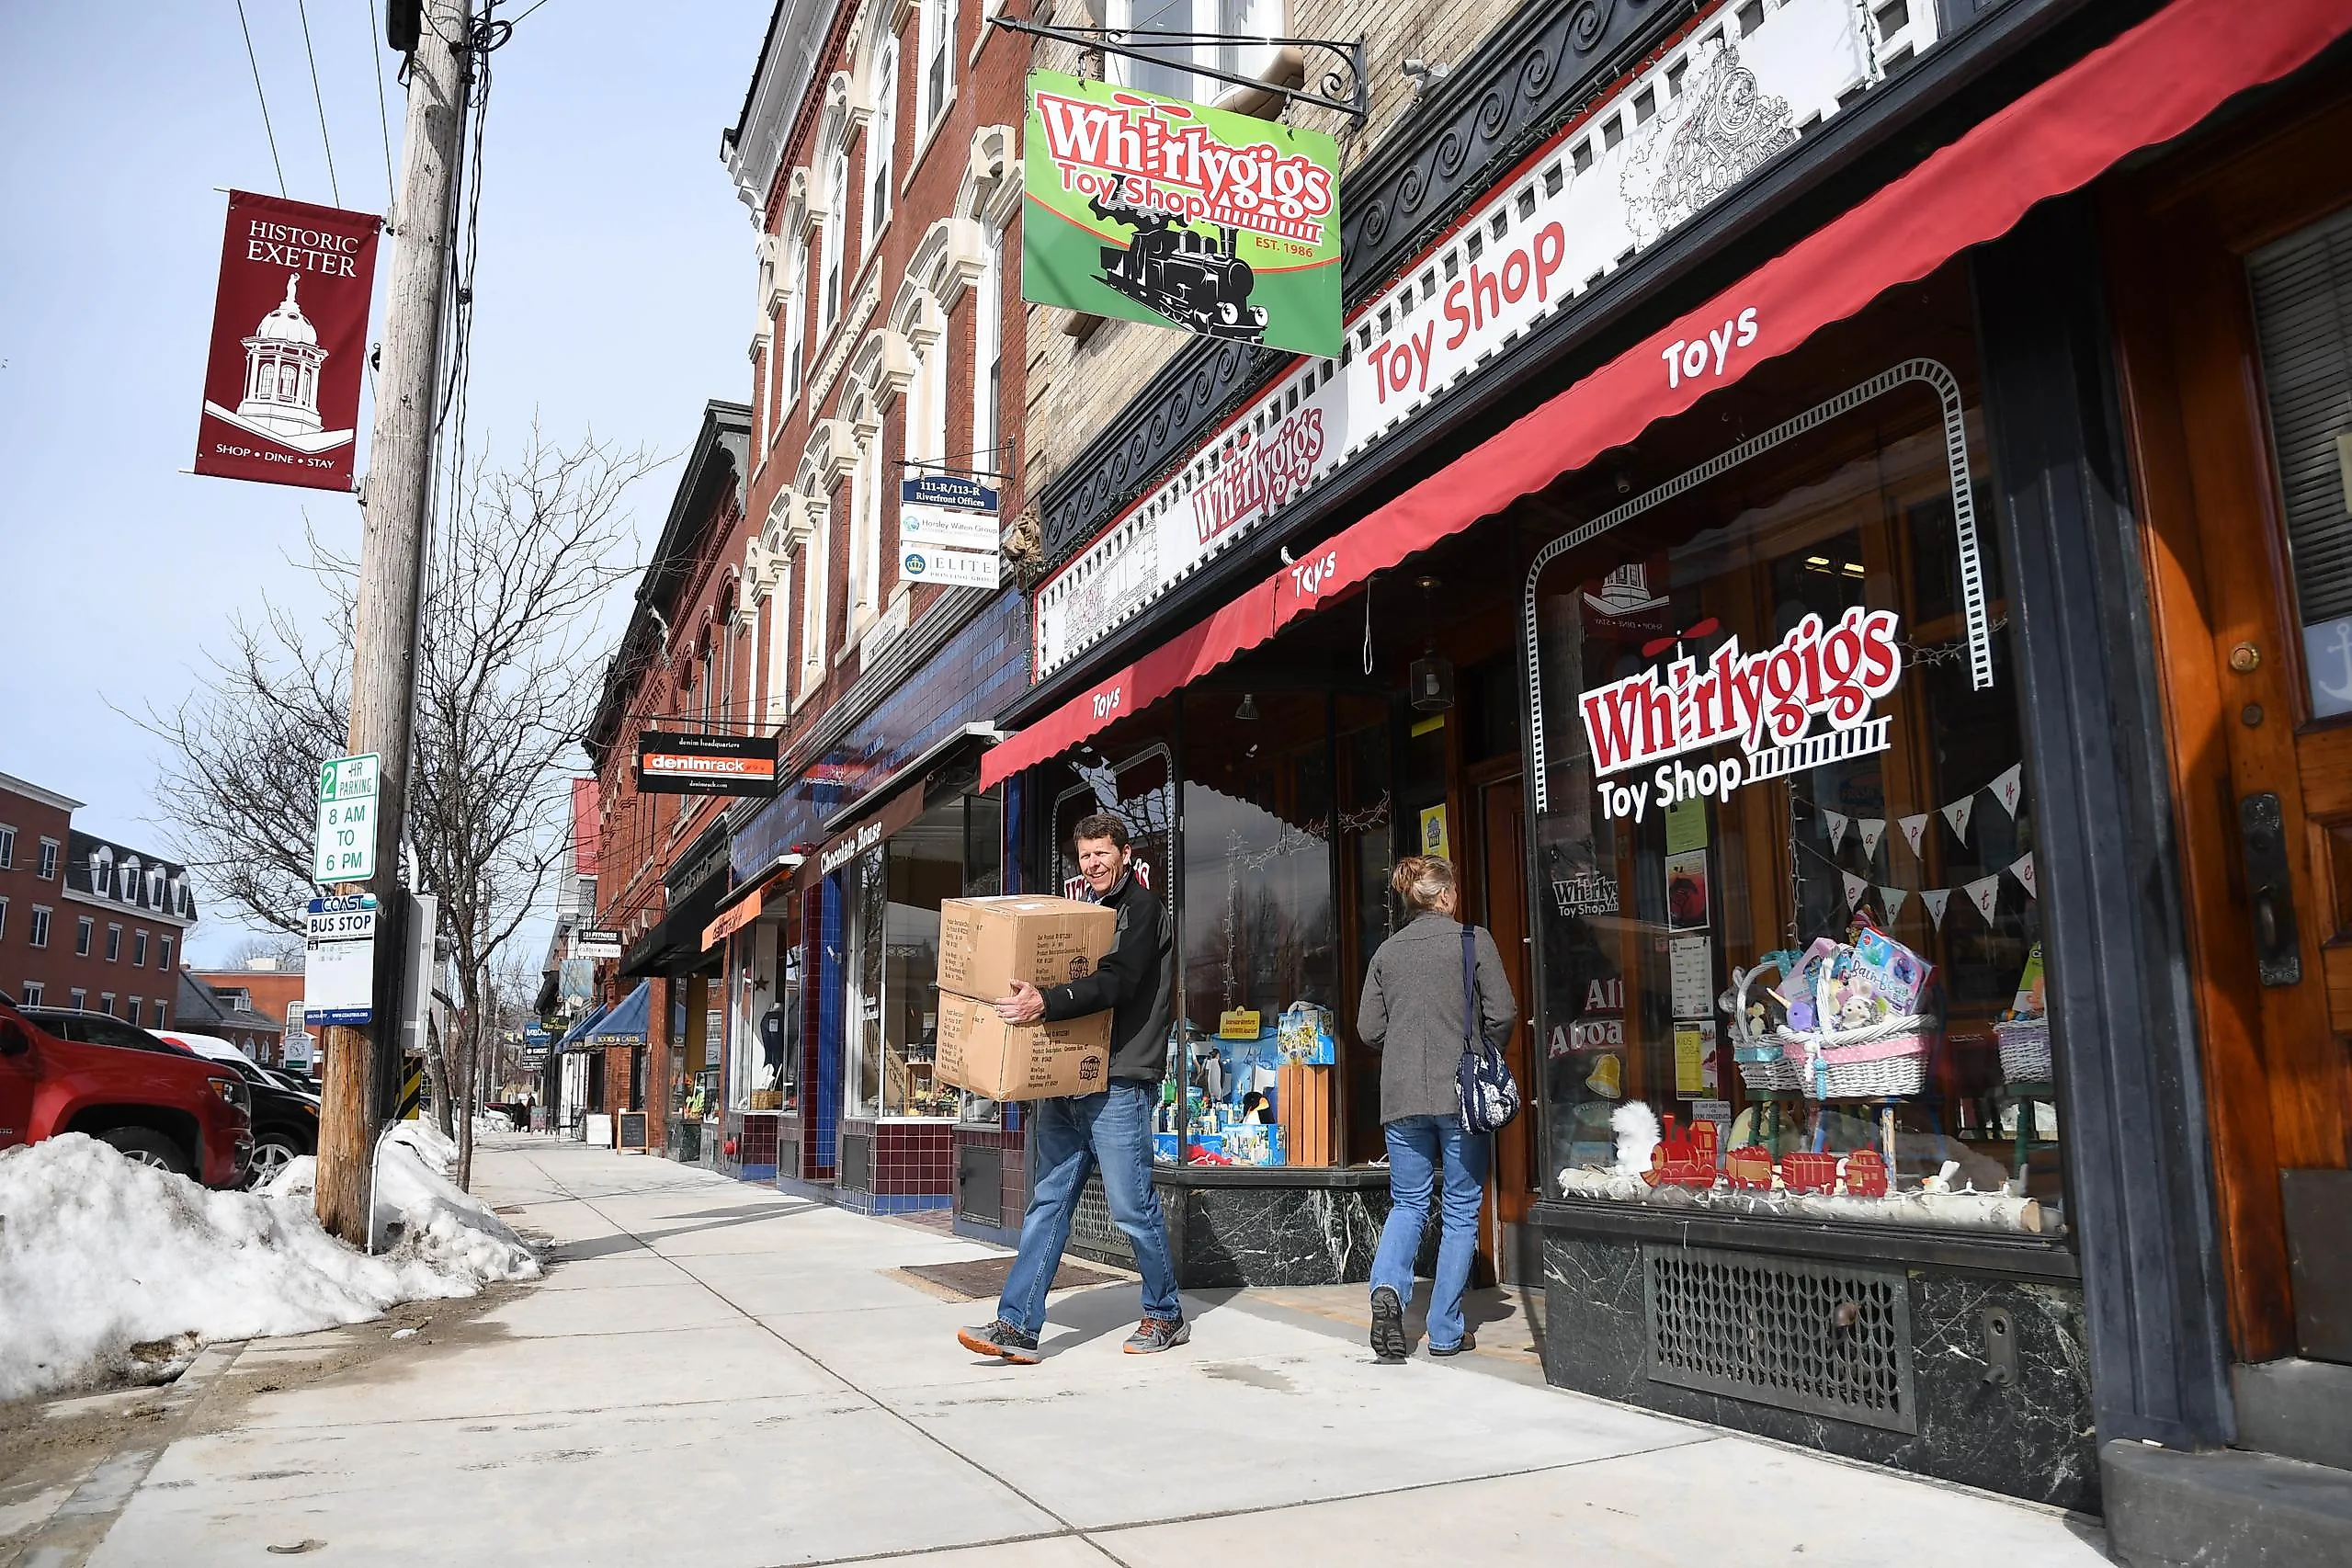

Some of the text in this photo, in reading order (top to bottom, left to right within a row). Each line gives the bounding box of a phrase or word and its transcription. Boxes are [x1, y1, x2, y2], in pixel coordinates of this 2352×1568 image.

[1038, 91, 1333, 222] Whirlygigs
[1058, 163, 1207, 224] Toy Shop
[249, 221, 359, 254] HISTORIC
[1256, 237, 1313, 258] EST. 1986
[246, 240, 358, 278] EXETER
[1368, 222, 1565, 403] Toy Shop
[216, 443, 335, 470] SHOP DINE STAY
[920, 482, 981, 496] 111-R/113-R
[1192, 407, 1325, 546] Whirlygigs
[915, 493, 985, 507] Riverfront Offices
[1580, 607, 1901, 776] Whirlygigs
[678, 737, 699, 746] denim
[349, 763, 363, 778] HR
[652, 756, 744, 772] denimrack
[322, 767, 336, 801] 2
[339, 778, 372, 796] PARKING
[1597, 780, 1648, 824] Toy
[1655, 755, 1743, 808] Shop
[329, 805, 365, 824] 8 AM
[336, 830, 355, 846] TO
[820, 821, 882, 875] Chocolate House
[326, 852, 363, 871] 6 PM
[323, 895, 364, 912] COAST
[1552, 876, 1618, 904] Whirly
[311, 915, 371, 933] BUS STOP
[1559, 903, 1605, 918] Toy Shop
[1585, 978, 1624, 1010] All
[1548, 1019, 1624, 1059] Aboa
